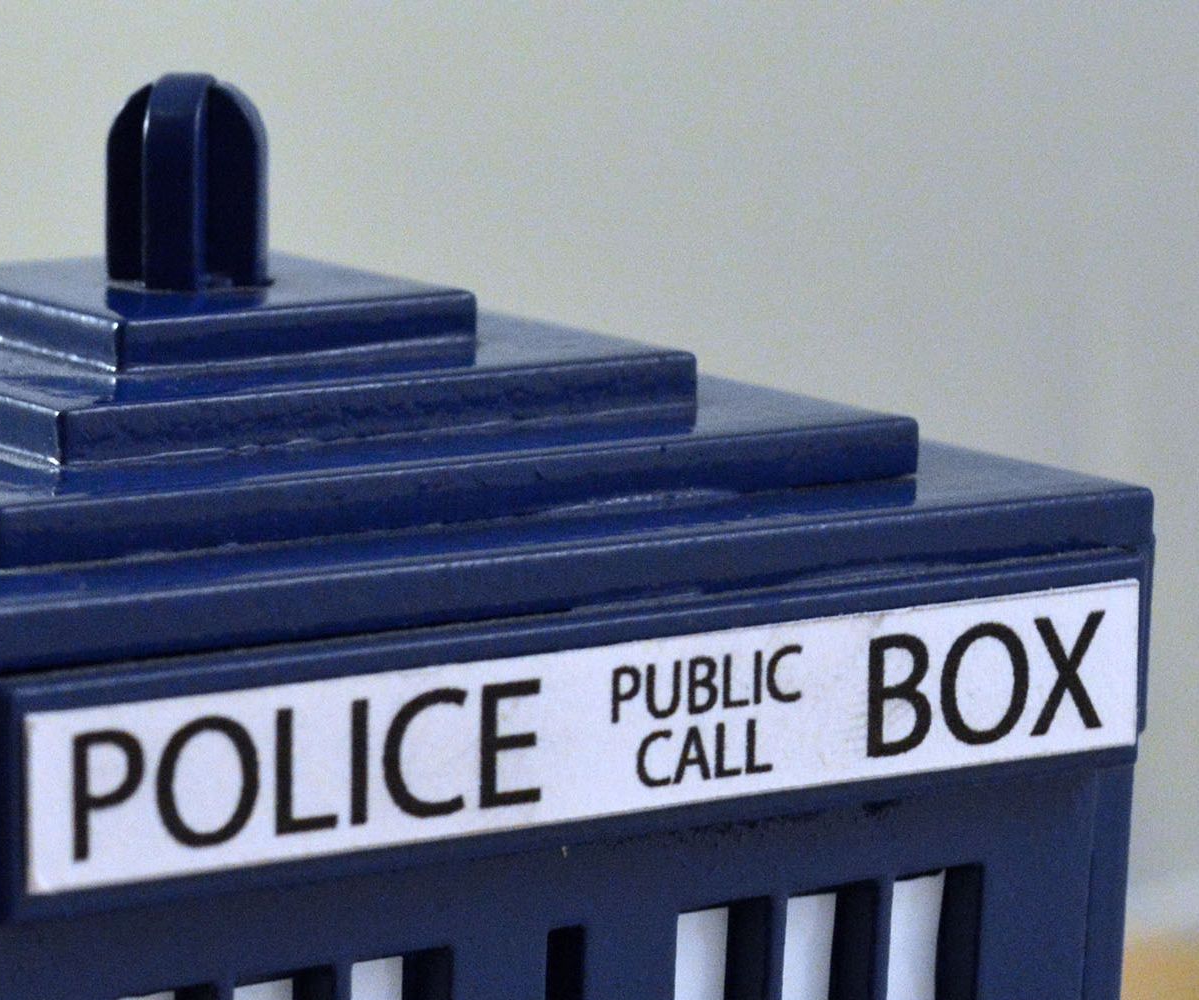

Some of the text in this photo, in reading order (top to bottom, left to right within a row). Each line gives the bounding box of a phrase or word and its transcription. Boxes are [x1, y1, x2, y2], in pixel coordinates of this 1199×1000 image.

[610, 644, 803, 724] PUBLIC
[866, 610, 1106, 759] BOX
[72, 678, 542, 863] POLICE
[636, 718, 773, 788] CALL
